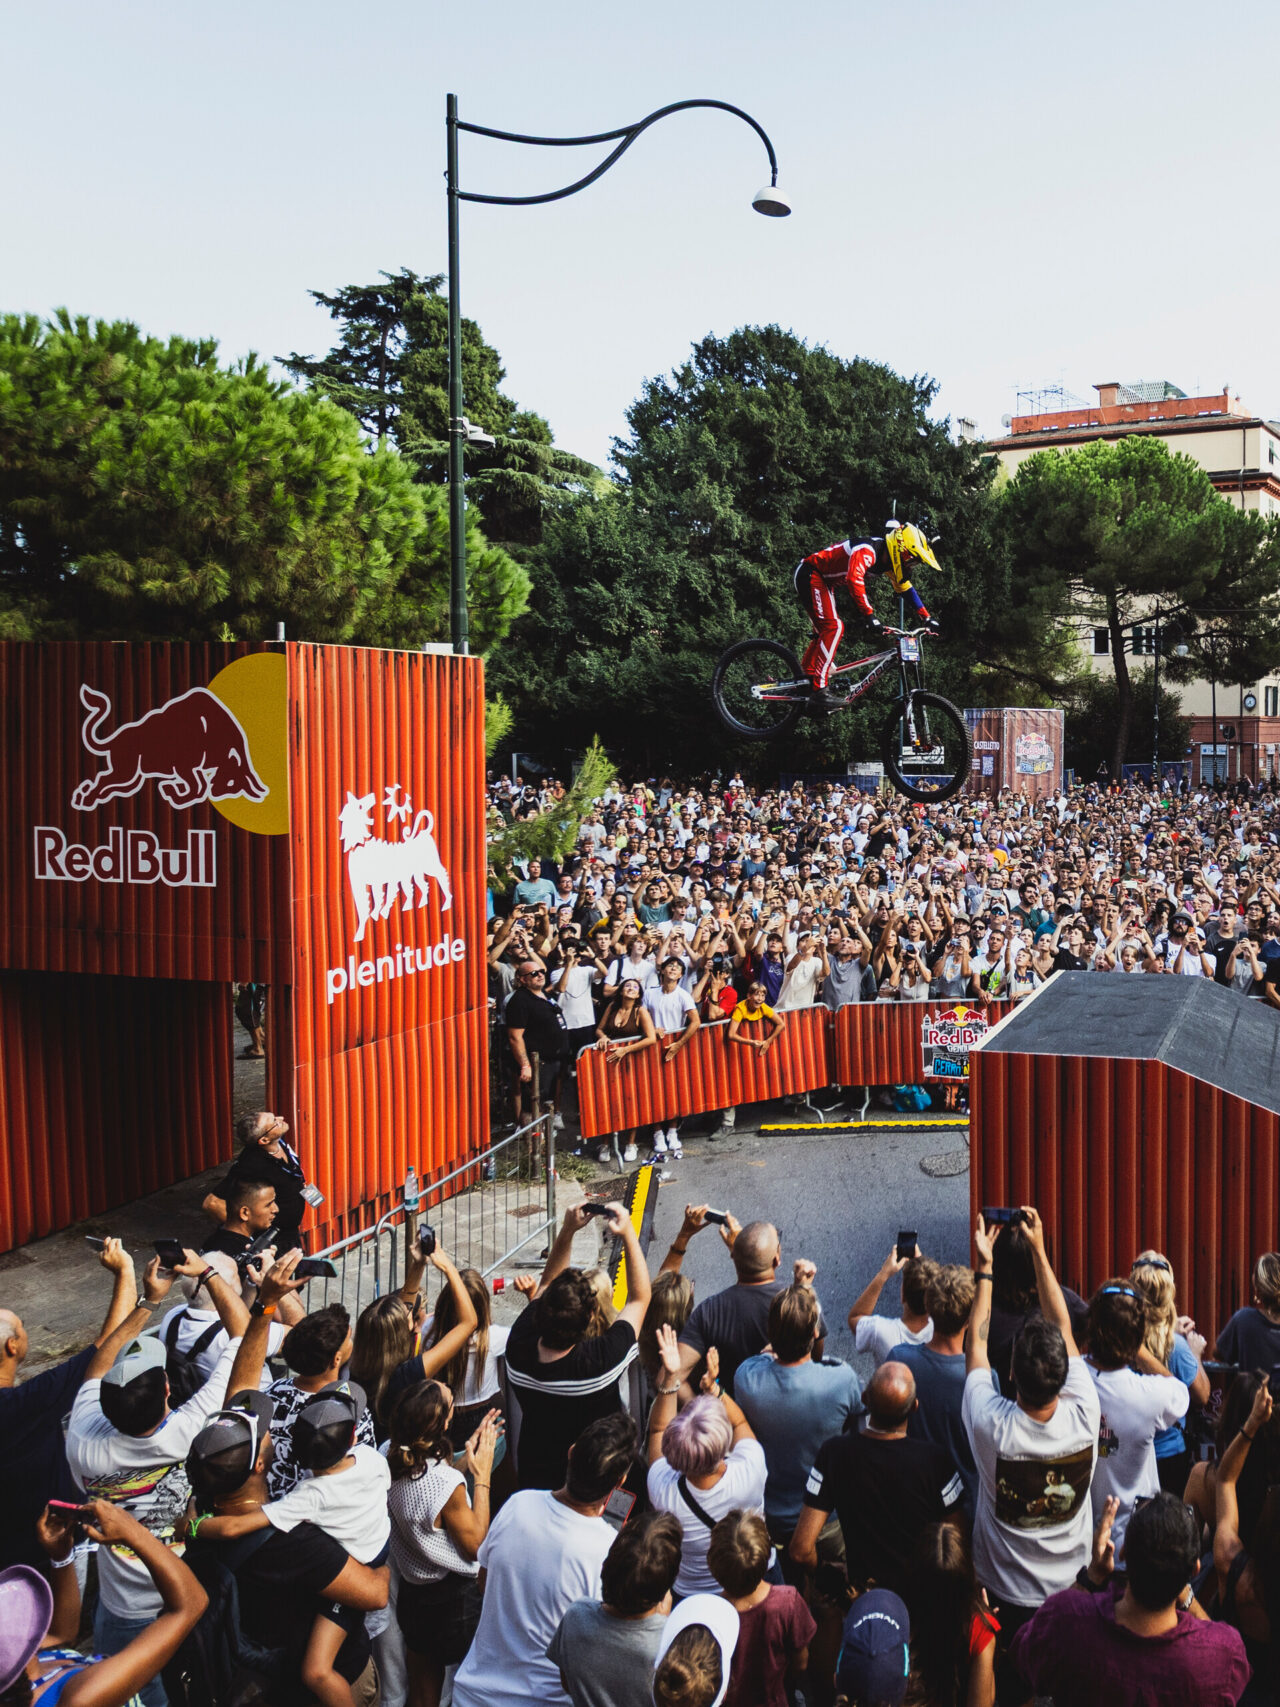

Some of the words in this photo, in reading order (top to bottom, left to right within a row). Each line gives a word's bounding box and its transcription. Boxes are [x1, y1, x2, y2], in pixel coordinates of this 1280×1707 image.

[34, 826, 124, 882] Red
[127, 829, 217, 887] Bull
[327, 933, 466, 1005] plenitude
[928, 1029, 960, 1045] Red
[934, 1059, 962, 1075] CERRO
